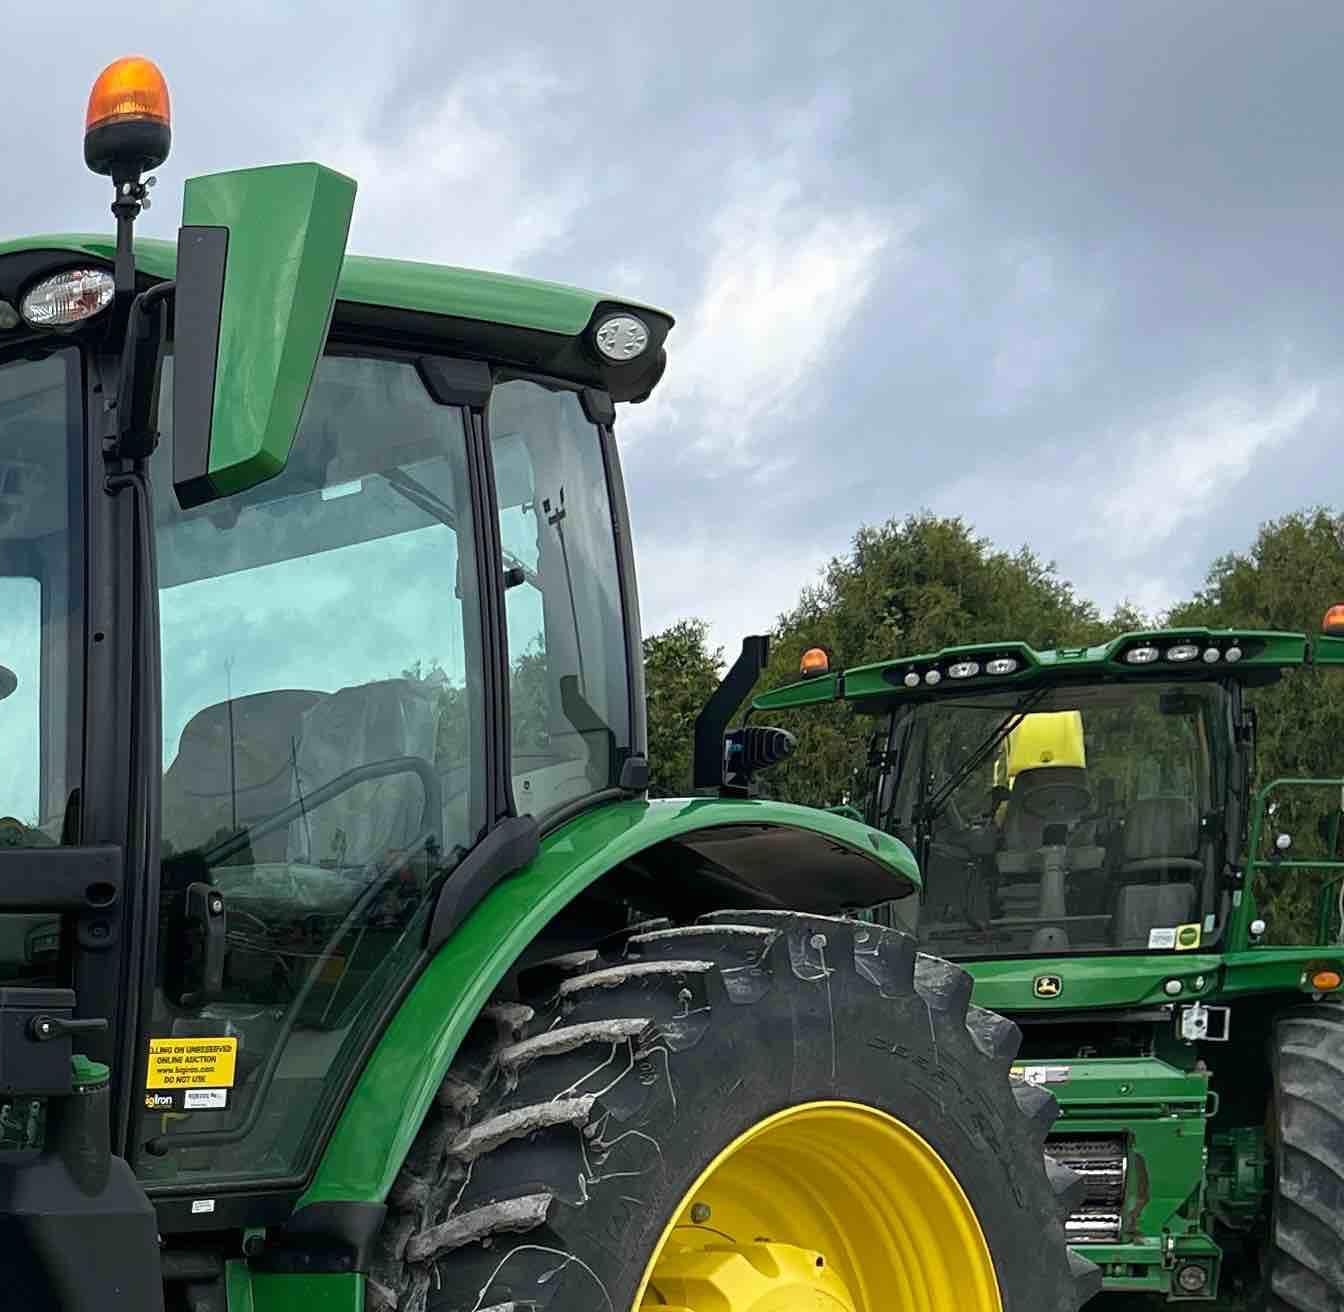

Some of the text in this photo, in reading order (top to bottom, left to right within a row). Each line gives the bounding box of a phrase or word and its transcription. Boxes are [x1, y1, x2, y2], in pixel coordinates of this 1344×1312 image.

[157, 1055, 217, 1065] ONLINE AUCTION
[163, 1076, 174, 1084] DO
[176, 1076, 190, 1084] NOT
[144, 1094, 173, 1108] igIron
